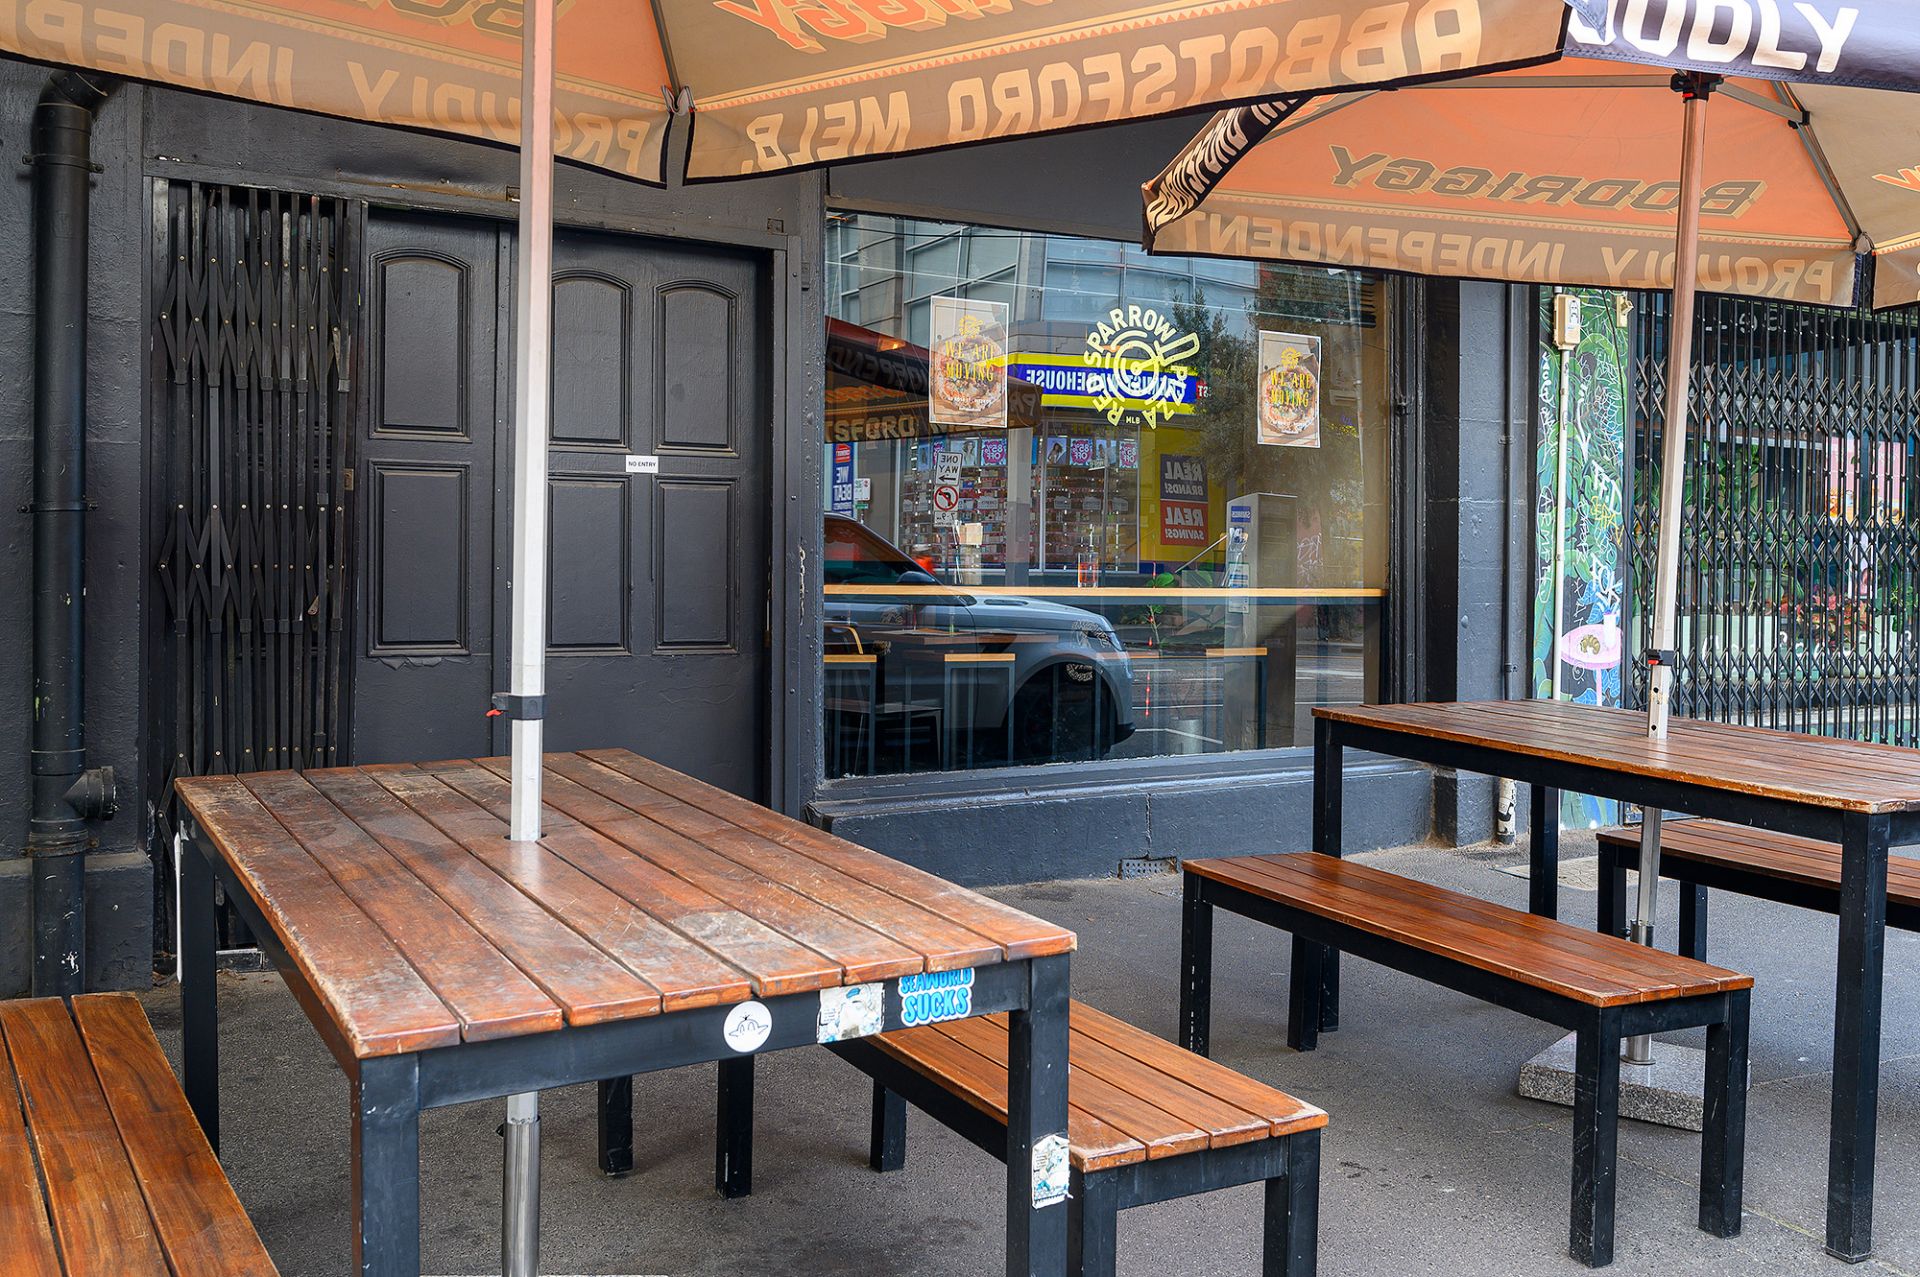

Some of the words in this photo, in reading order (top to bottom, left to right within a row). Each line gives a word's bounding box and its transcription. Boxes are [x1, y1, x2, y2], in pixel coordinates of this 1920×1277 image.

[1083, 305, 1177, 369] SPARROW
[945, 341, 965, 358] WE
[946, 362, 994, 381] MOVING
[1270, 370, 1287, 386] WE
[1292, 373, 1312, 389] ARE
[1271, 388, 1309, 407] MOVING
[1125, 415, 1141, 424] MLB
[904, 987, 969, 1023] SUCKS
